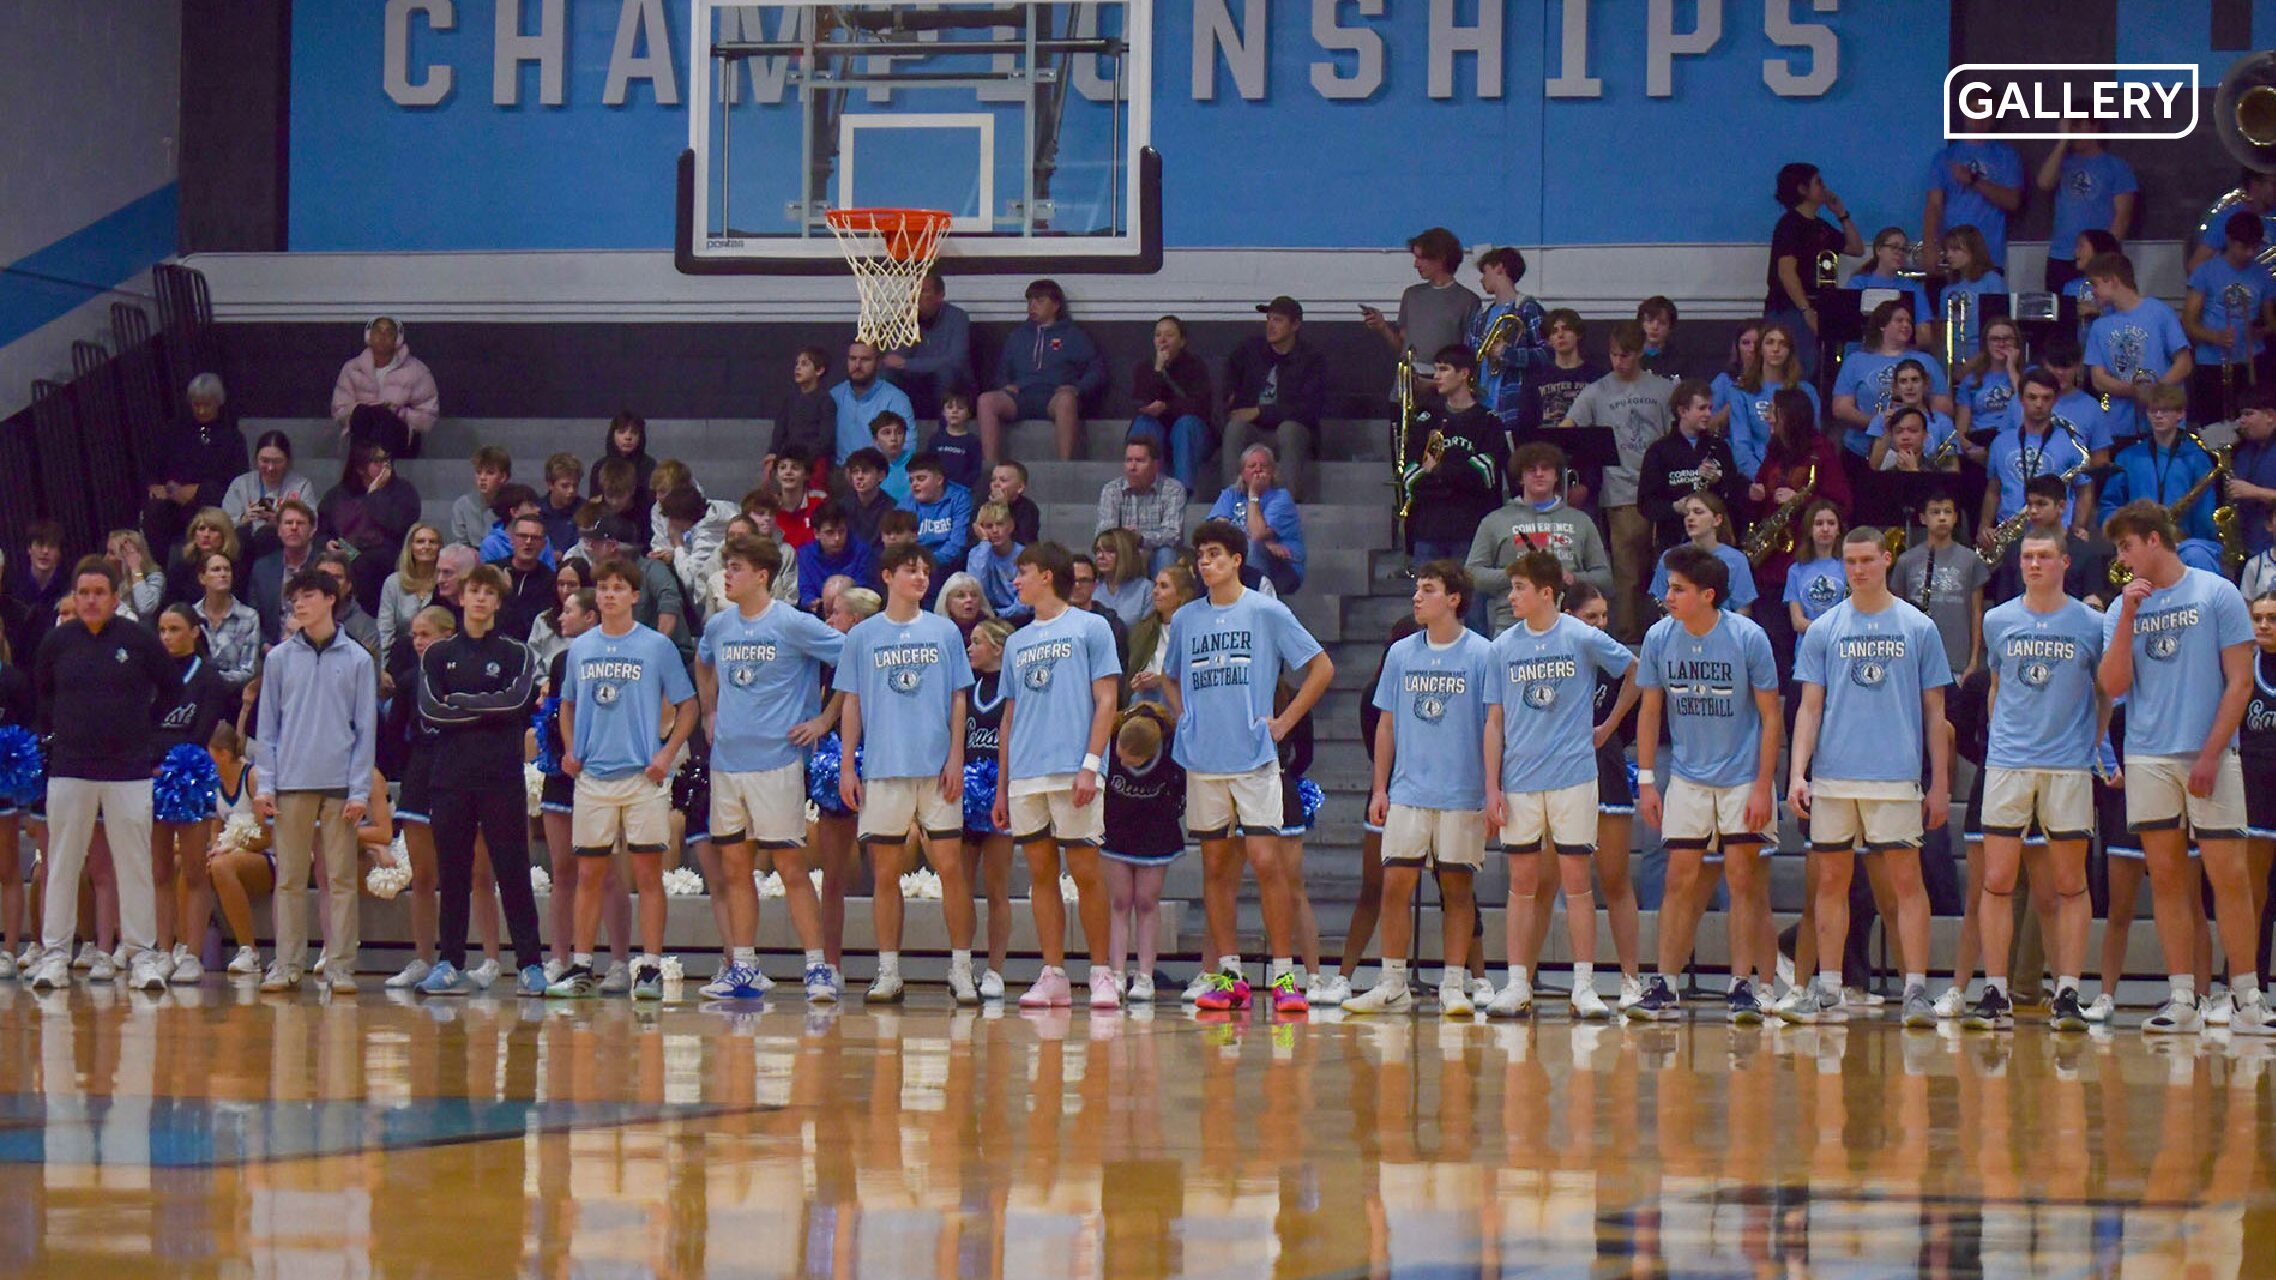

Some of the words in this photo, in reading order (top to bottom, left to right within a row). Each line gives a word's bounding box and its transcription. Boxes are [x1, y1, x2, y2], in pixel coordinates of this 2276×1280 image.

[2132, 608, 2199, 635] LANCERS
[721, 645, 777, 662] LANCERS
[1192, 630, 1252, 656] LANCER
[1839, 641, 1905, 658] LANCERS
[2007, 639, 2075, 660] LANCERS
[874, 648, 939, 669] LANCERS
[1016, 643, 1072, 668] LANCERS
[580, 662, 641, 681] LANCERS
[1510, 660, 1576, 683] LANCERS
[1668, 660, 1733, 681] LANCER
[1405, 675, 1466, 694] LANCERS
